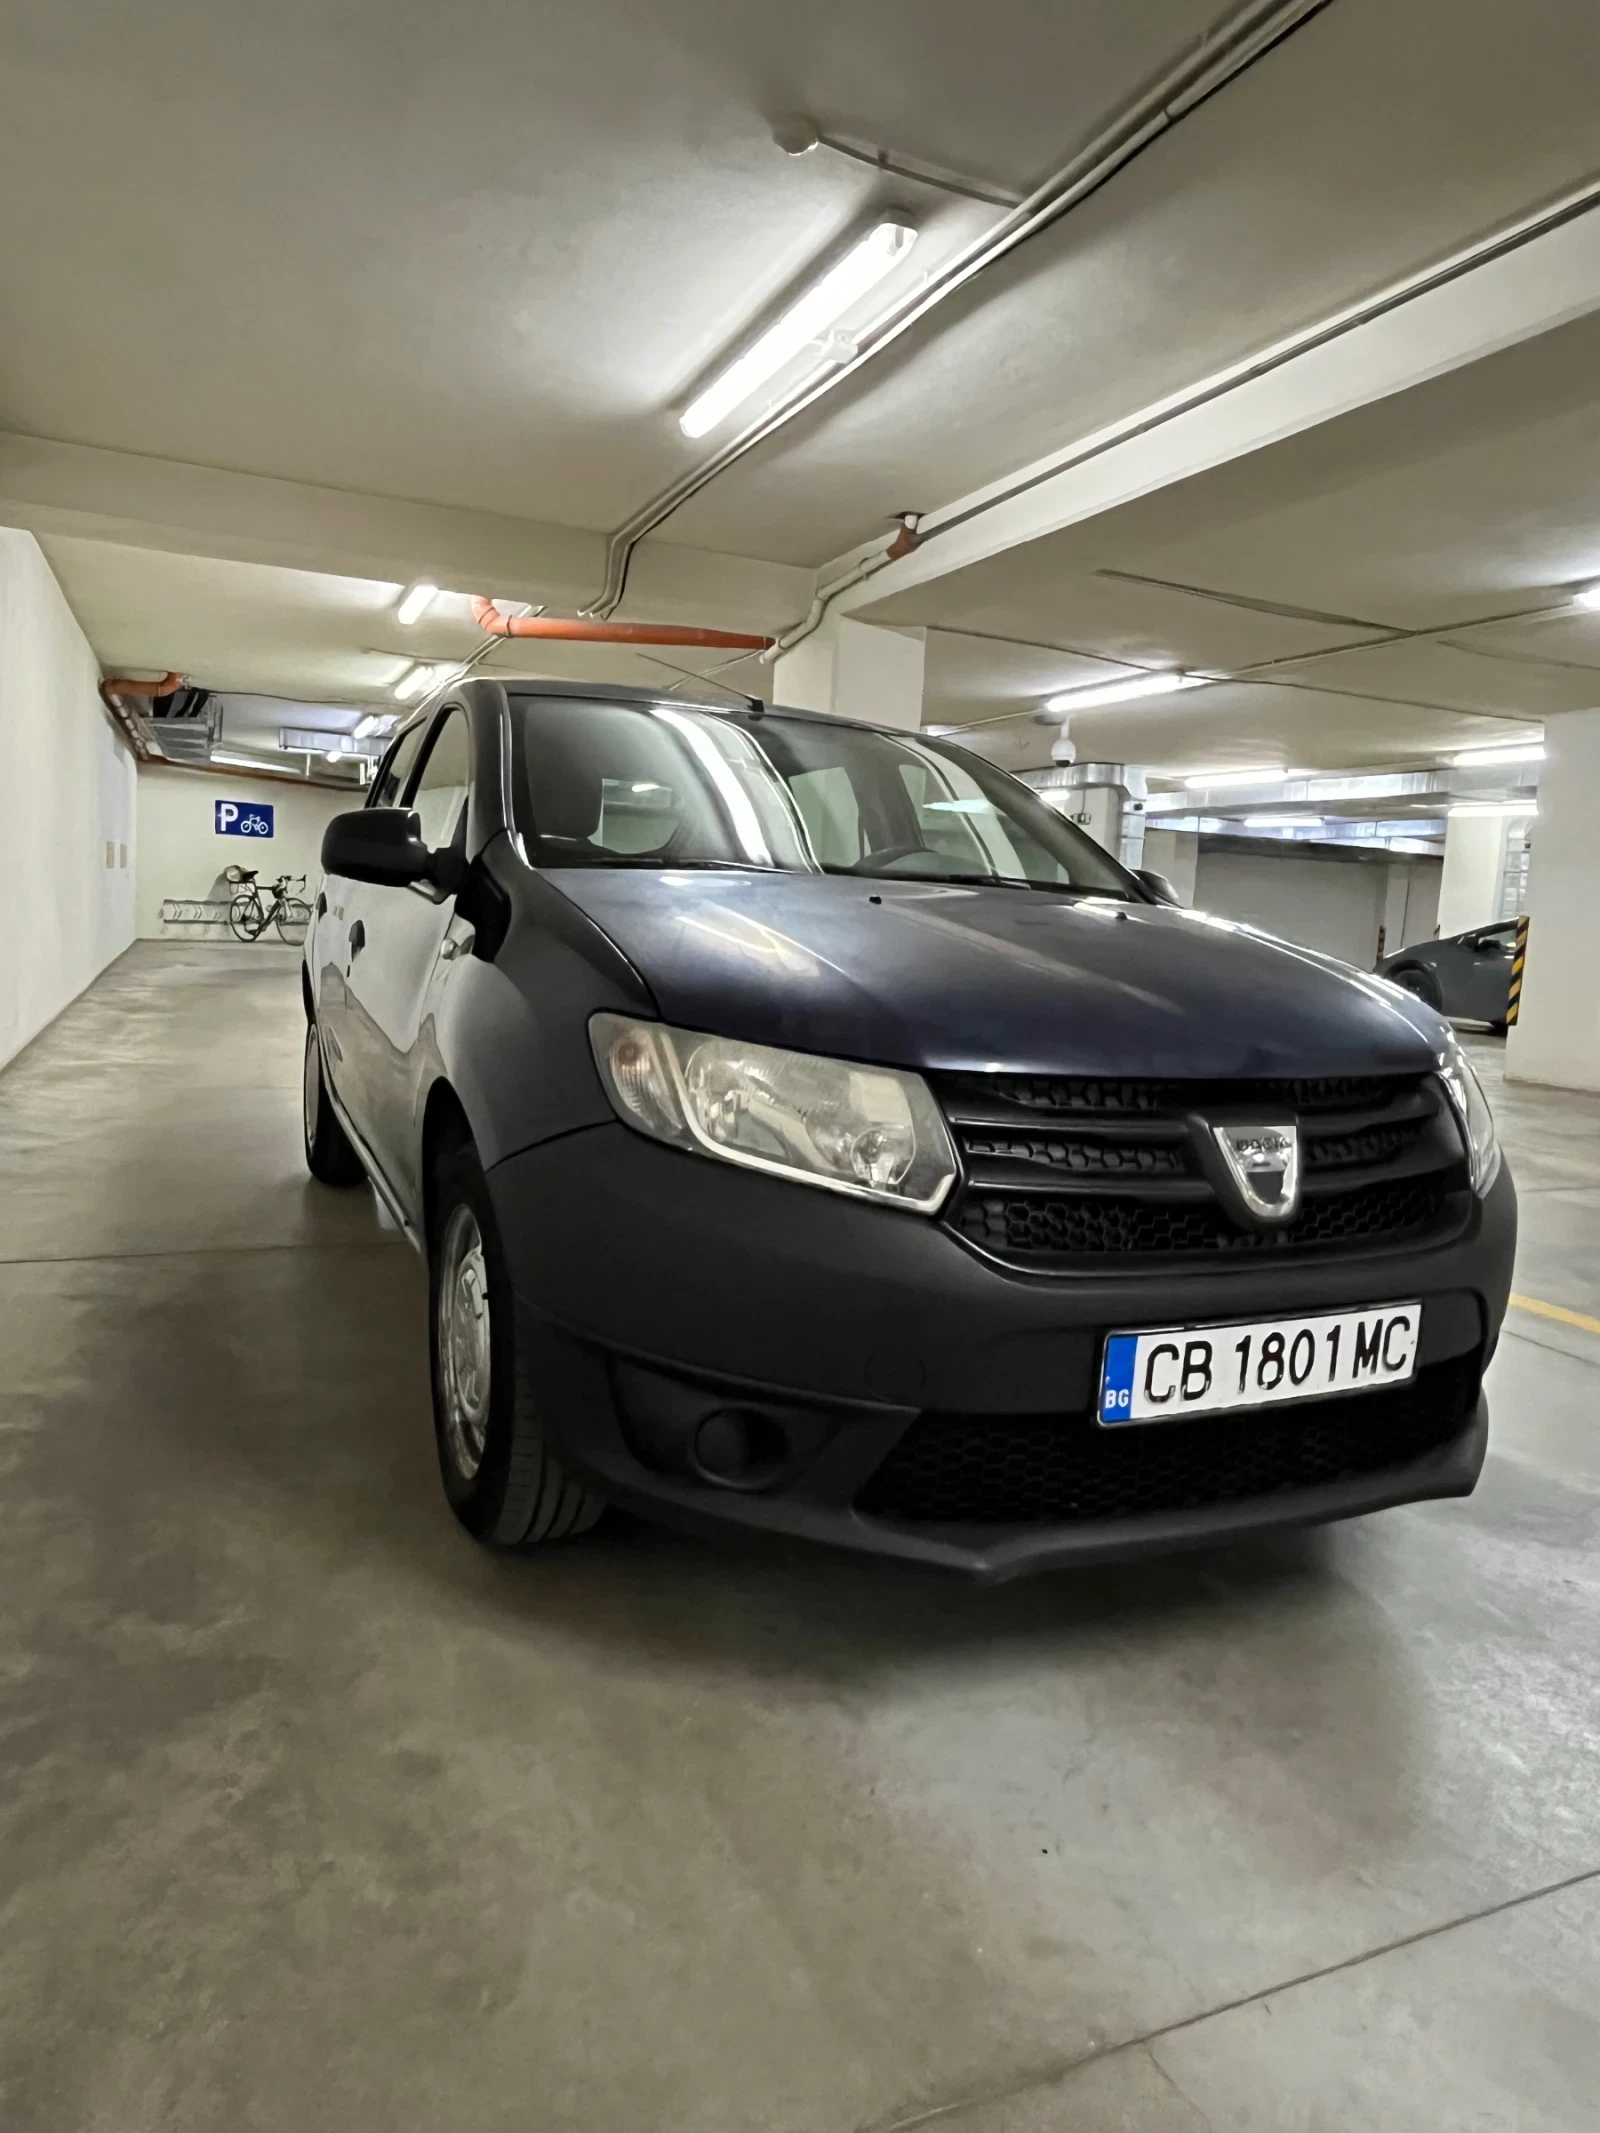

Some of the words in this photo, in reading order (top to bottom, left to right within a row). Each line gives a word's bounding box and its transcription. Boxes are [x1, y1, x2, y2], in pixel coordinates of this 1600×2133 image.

[221, 803, 238, 831] P
[1144, 1340, 1212, 1403] CB
[1235, 1325, 1341, 1394] 1801
[1352, 1315, 1410, 1378] MC
[1105, 1389, 1129, 1408] BG
